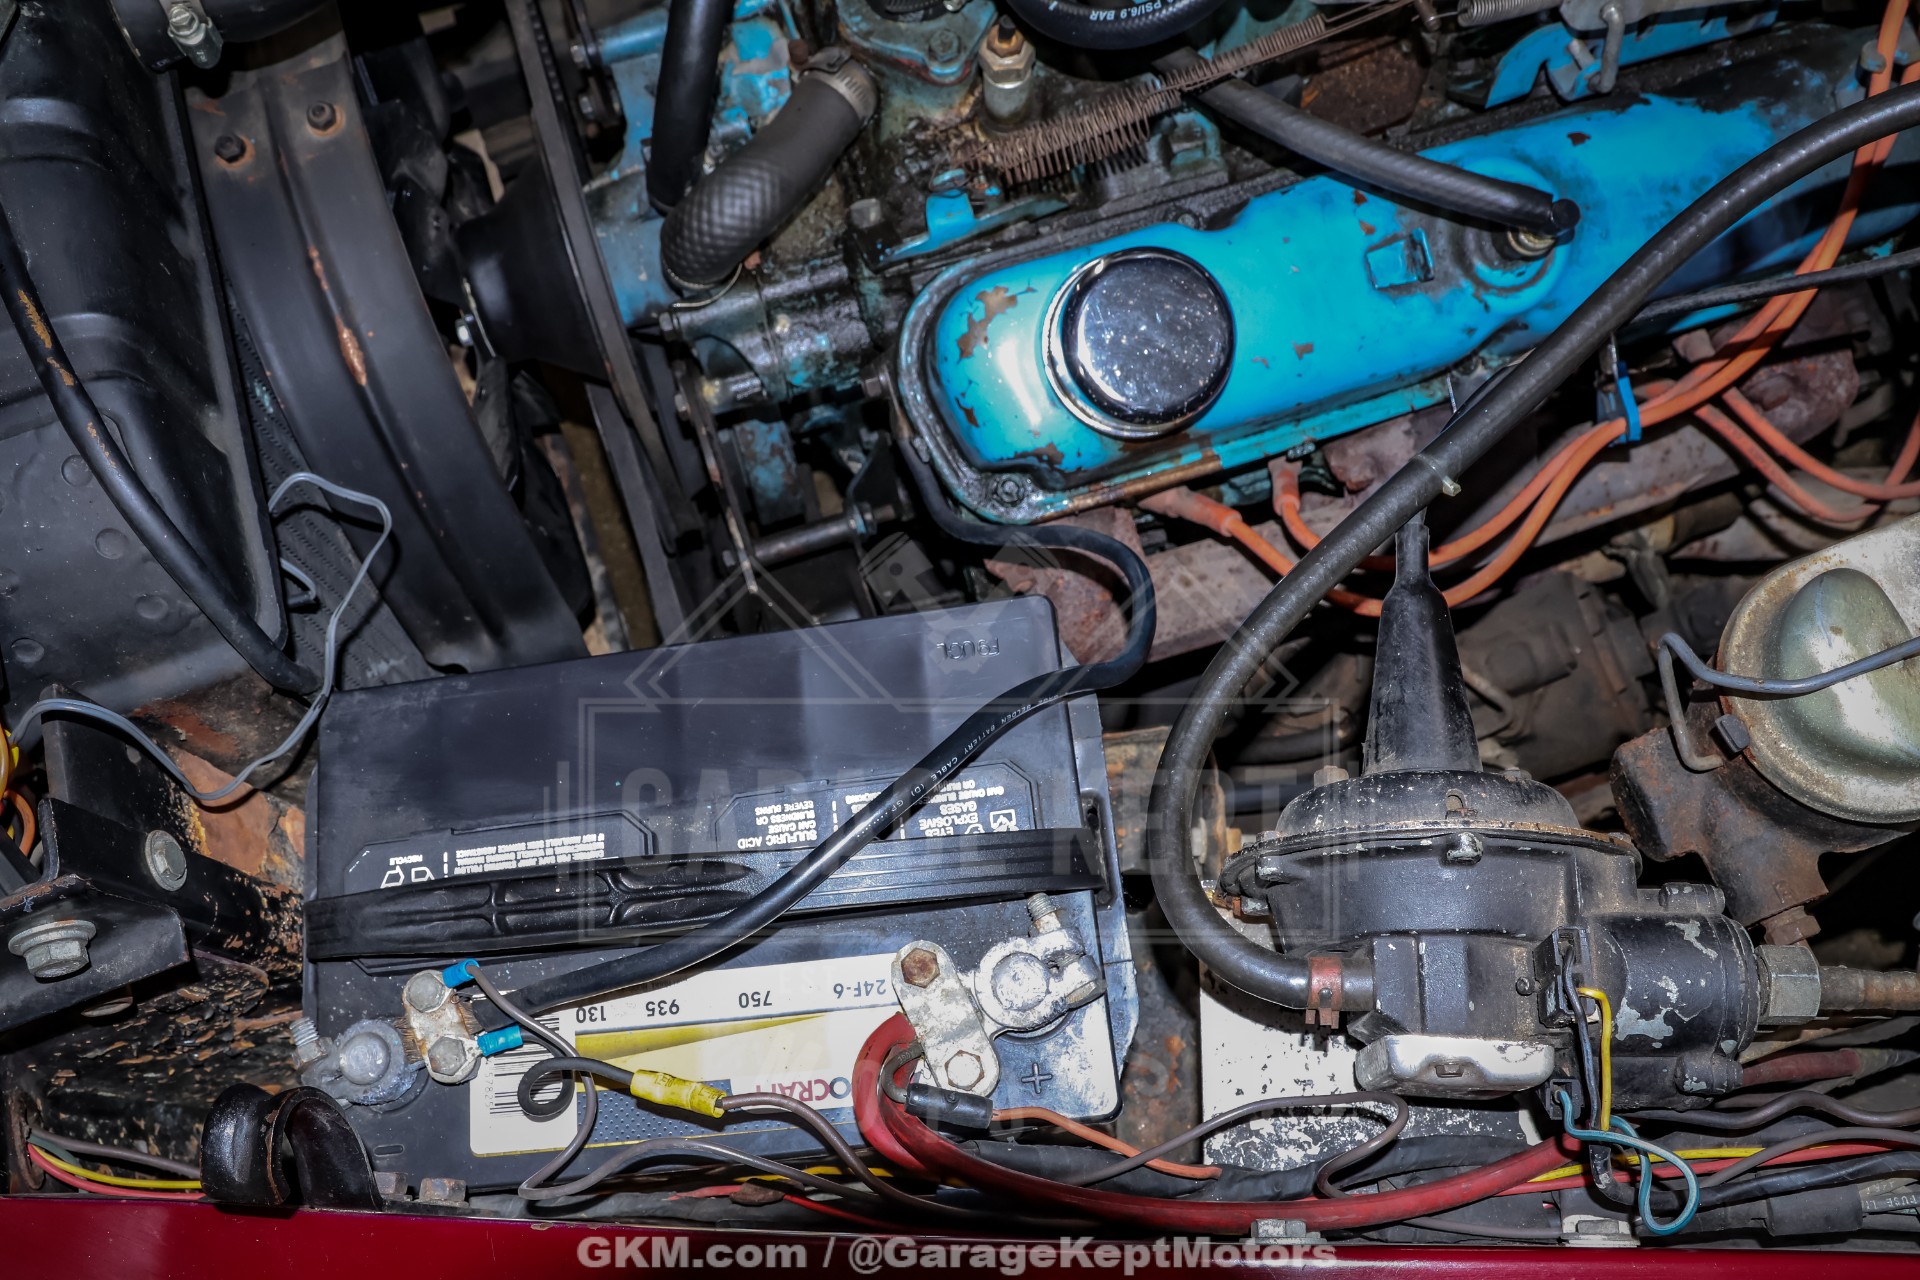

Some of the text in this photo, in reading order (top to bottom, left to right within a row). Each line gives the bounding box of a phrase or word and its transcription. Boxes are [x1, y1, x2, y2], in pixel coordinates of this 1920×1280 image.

[1089, 9, 1116, 21] BAR
[963, 723, 996, 755] BATTERY
[930, 756, 958, 782] CABLE
[754, 800, 814, 815] SEVERE BURNS
[939, 800, 977, 815] GASES
[756, 814, 769, 825] OR
[768, 820, 816, 834] CAN CAUSE
[918, 812, 979, 831] EXPLOSIVE
[737, 830, 818, 849] SULFURIC ACID
[575, 978, 887, 1024] 24F-6 750 935 130
